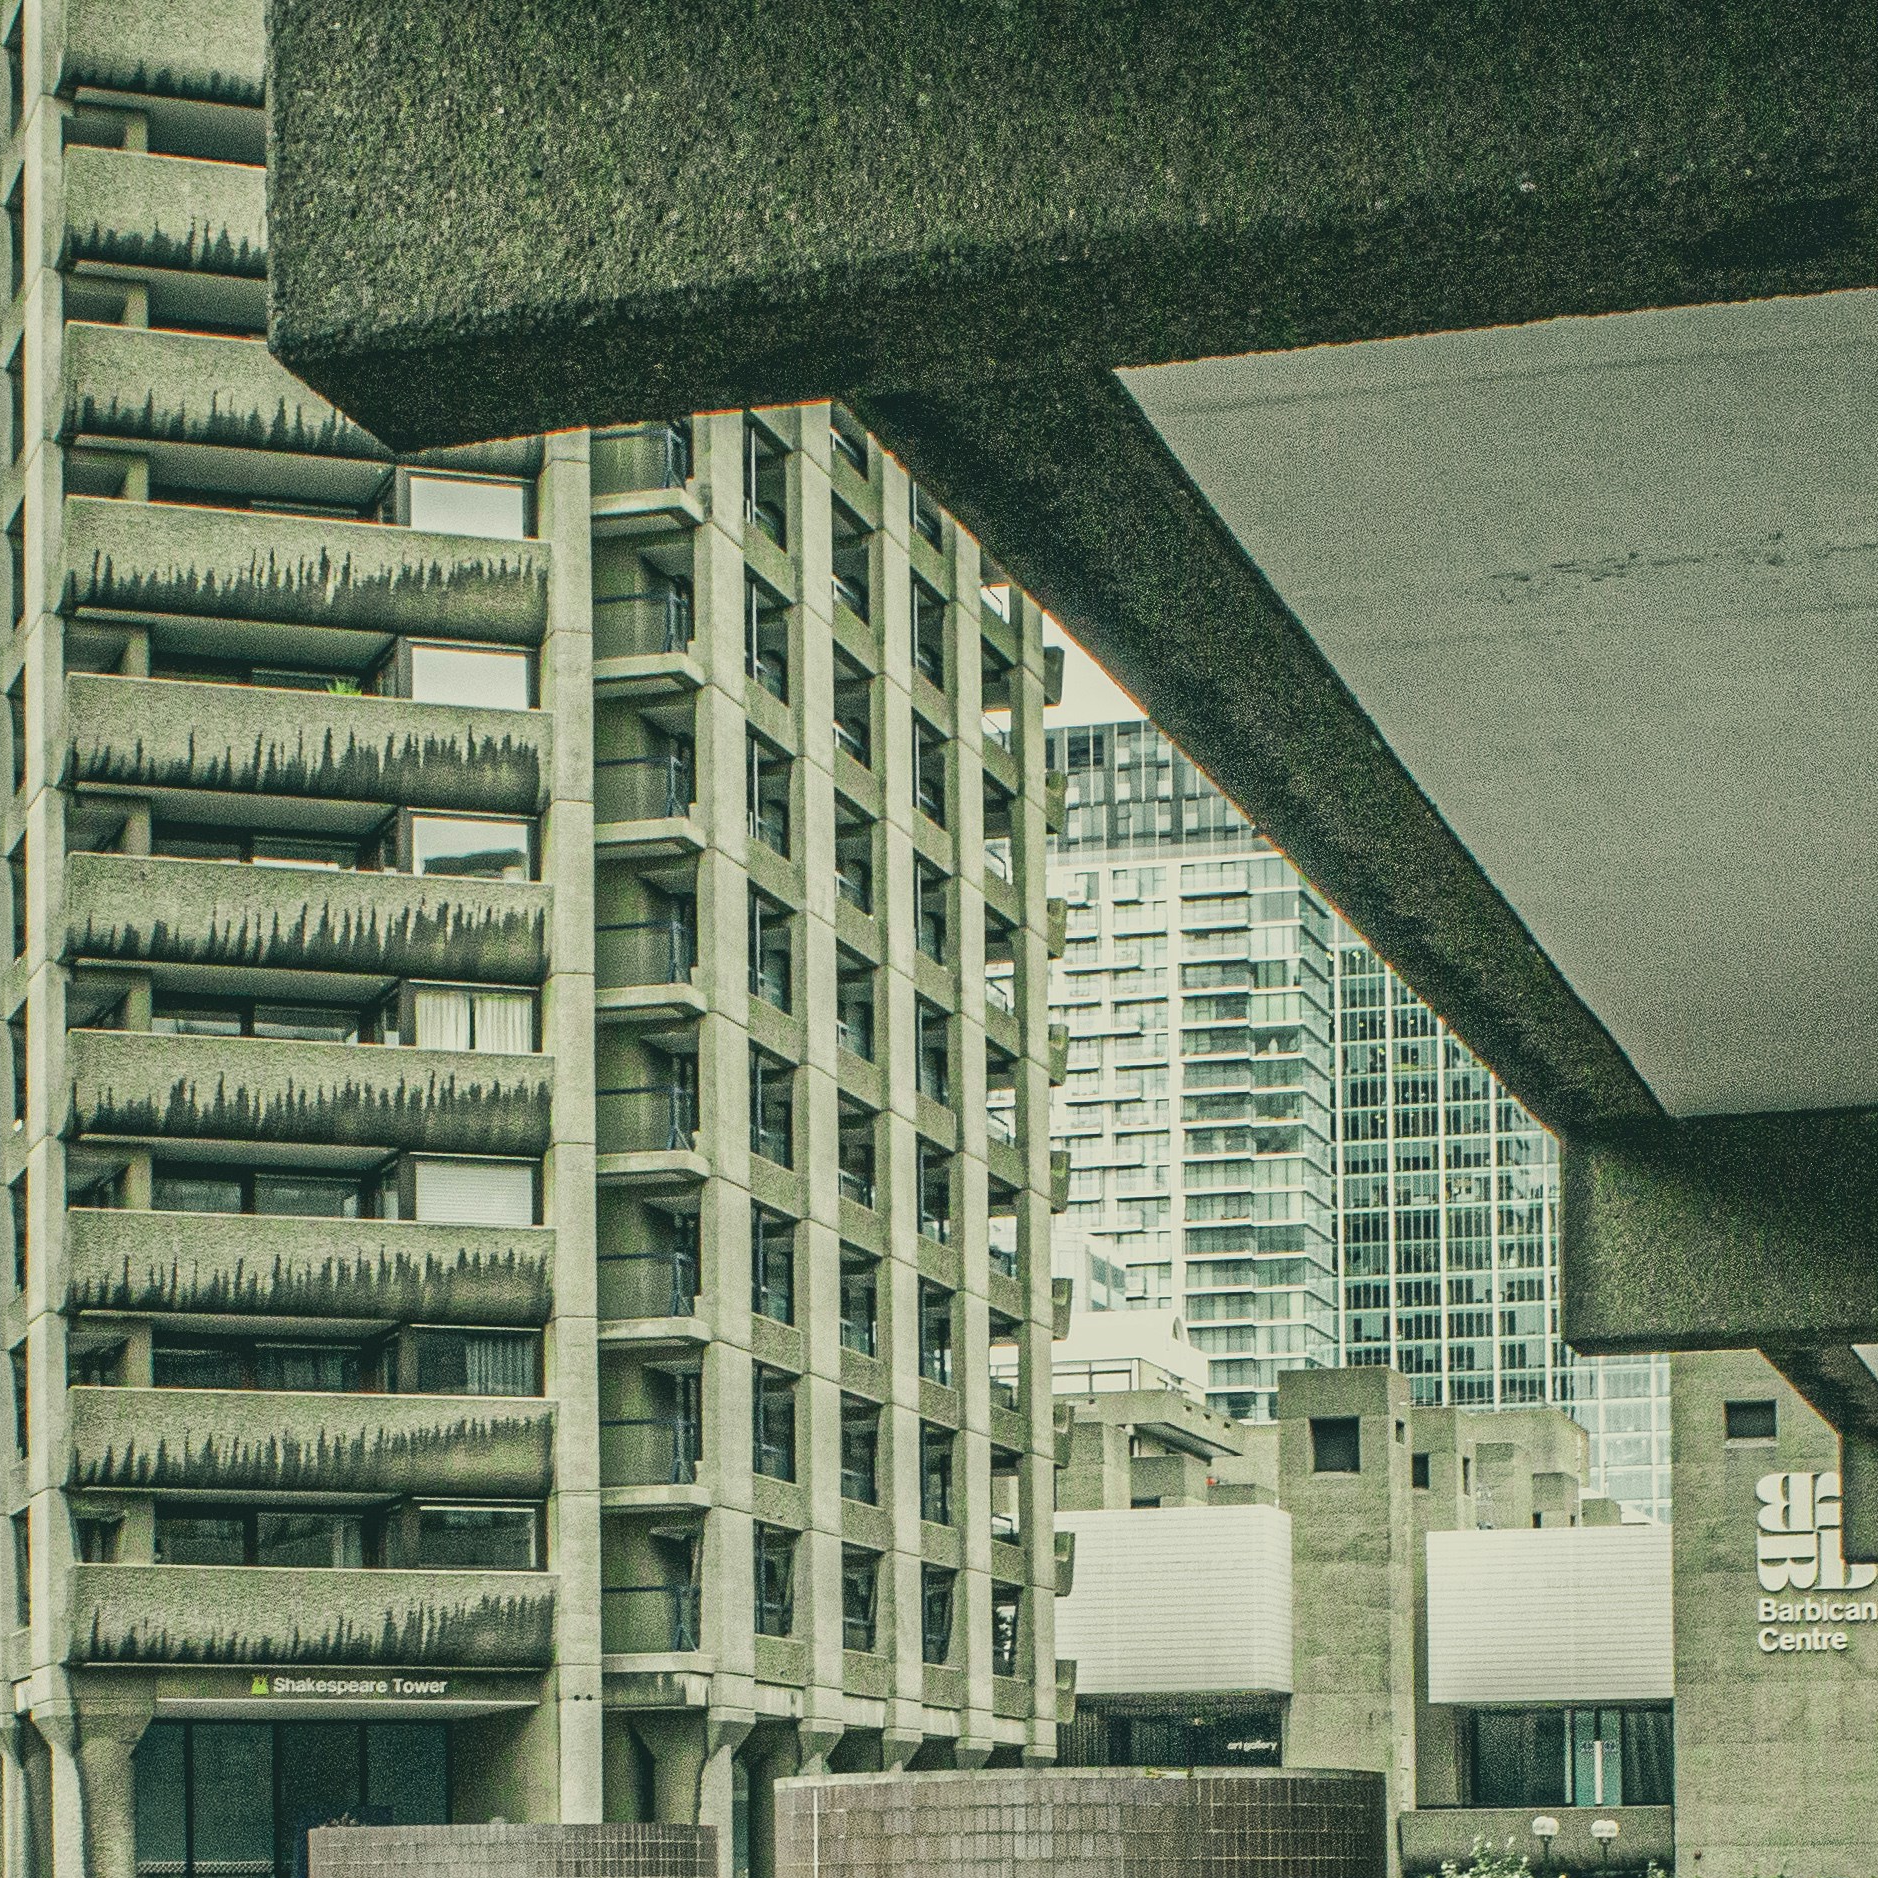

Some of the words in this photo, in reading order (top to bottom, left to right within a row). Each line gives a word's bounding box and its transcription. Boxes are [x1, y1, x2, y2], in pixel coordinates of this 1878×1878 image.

[1758, 1598, 1878, 1622] Barbican
[1758, 1627, 1848, 1652] Centre
[273, 1677, 389, 1695] Shakespeare
[392, 1678, 448, 1693] Tower
